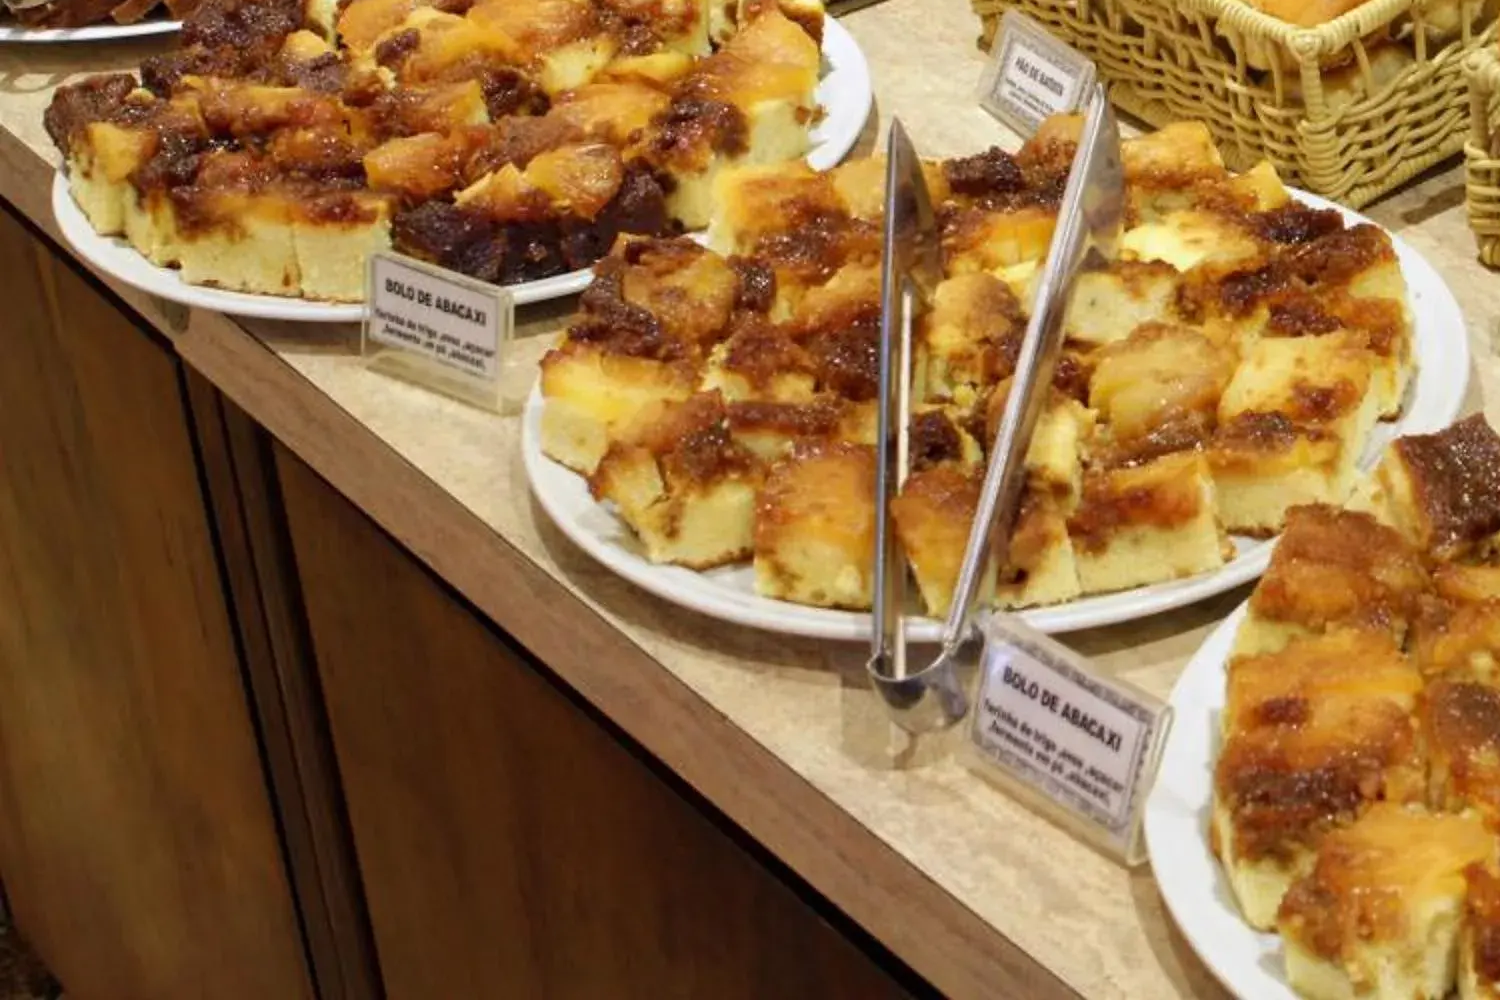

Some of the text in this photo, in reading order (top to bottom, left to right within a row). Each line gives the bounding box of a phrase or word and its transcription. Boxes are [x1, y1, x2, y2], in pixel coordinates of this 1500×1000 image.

[385, 277, 487, 327] BOLO DE ABACAXI
[1002, 665, 1123, 753] BOLO DE ABACAXI
